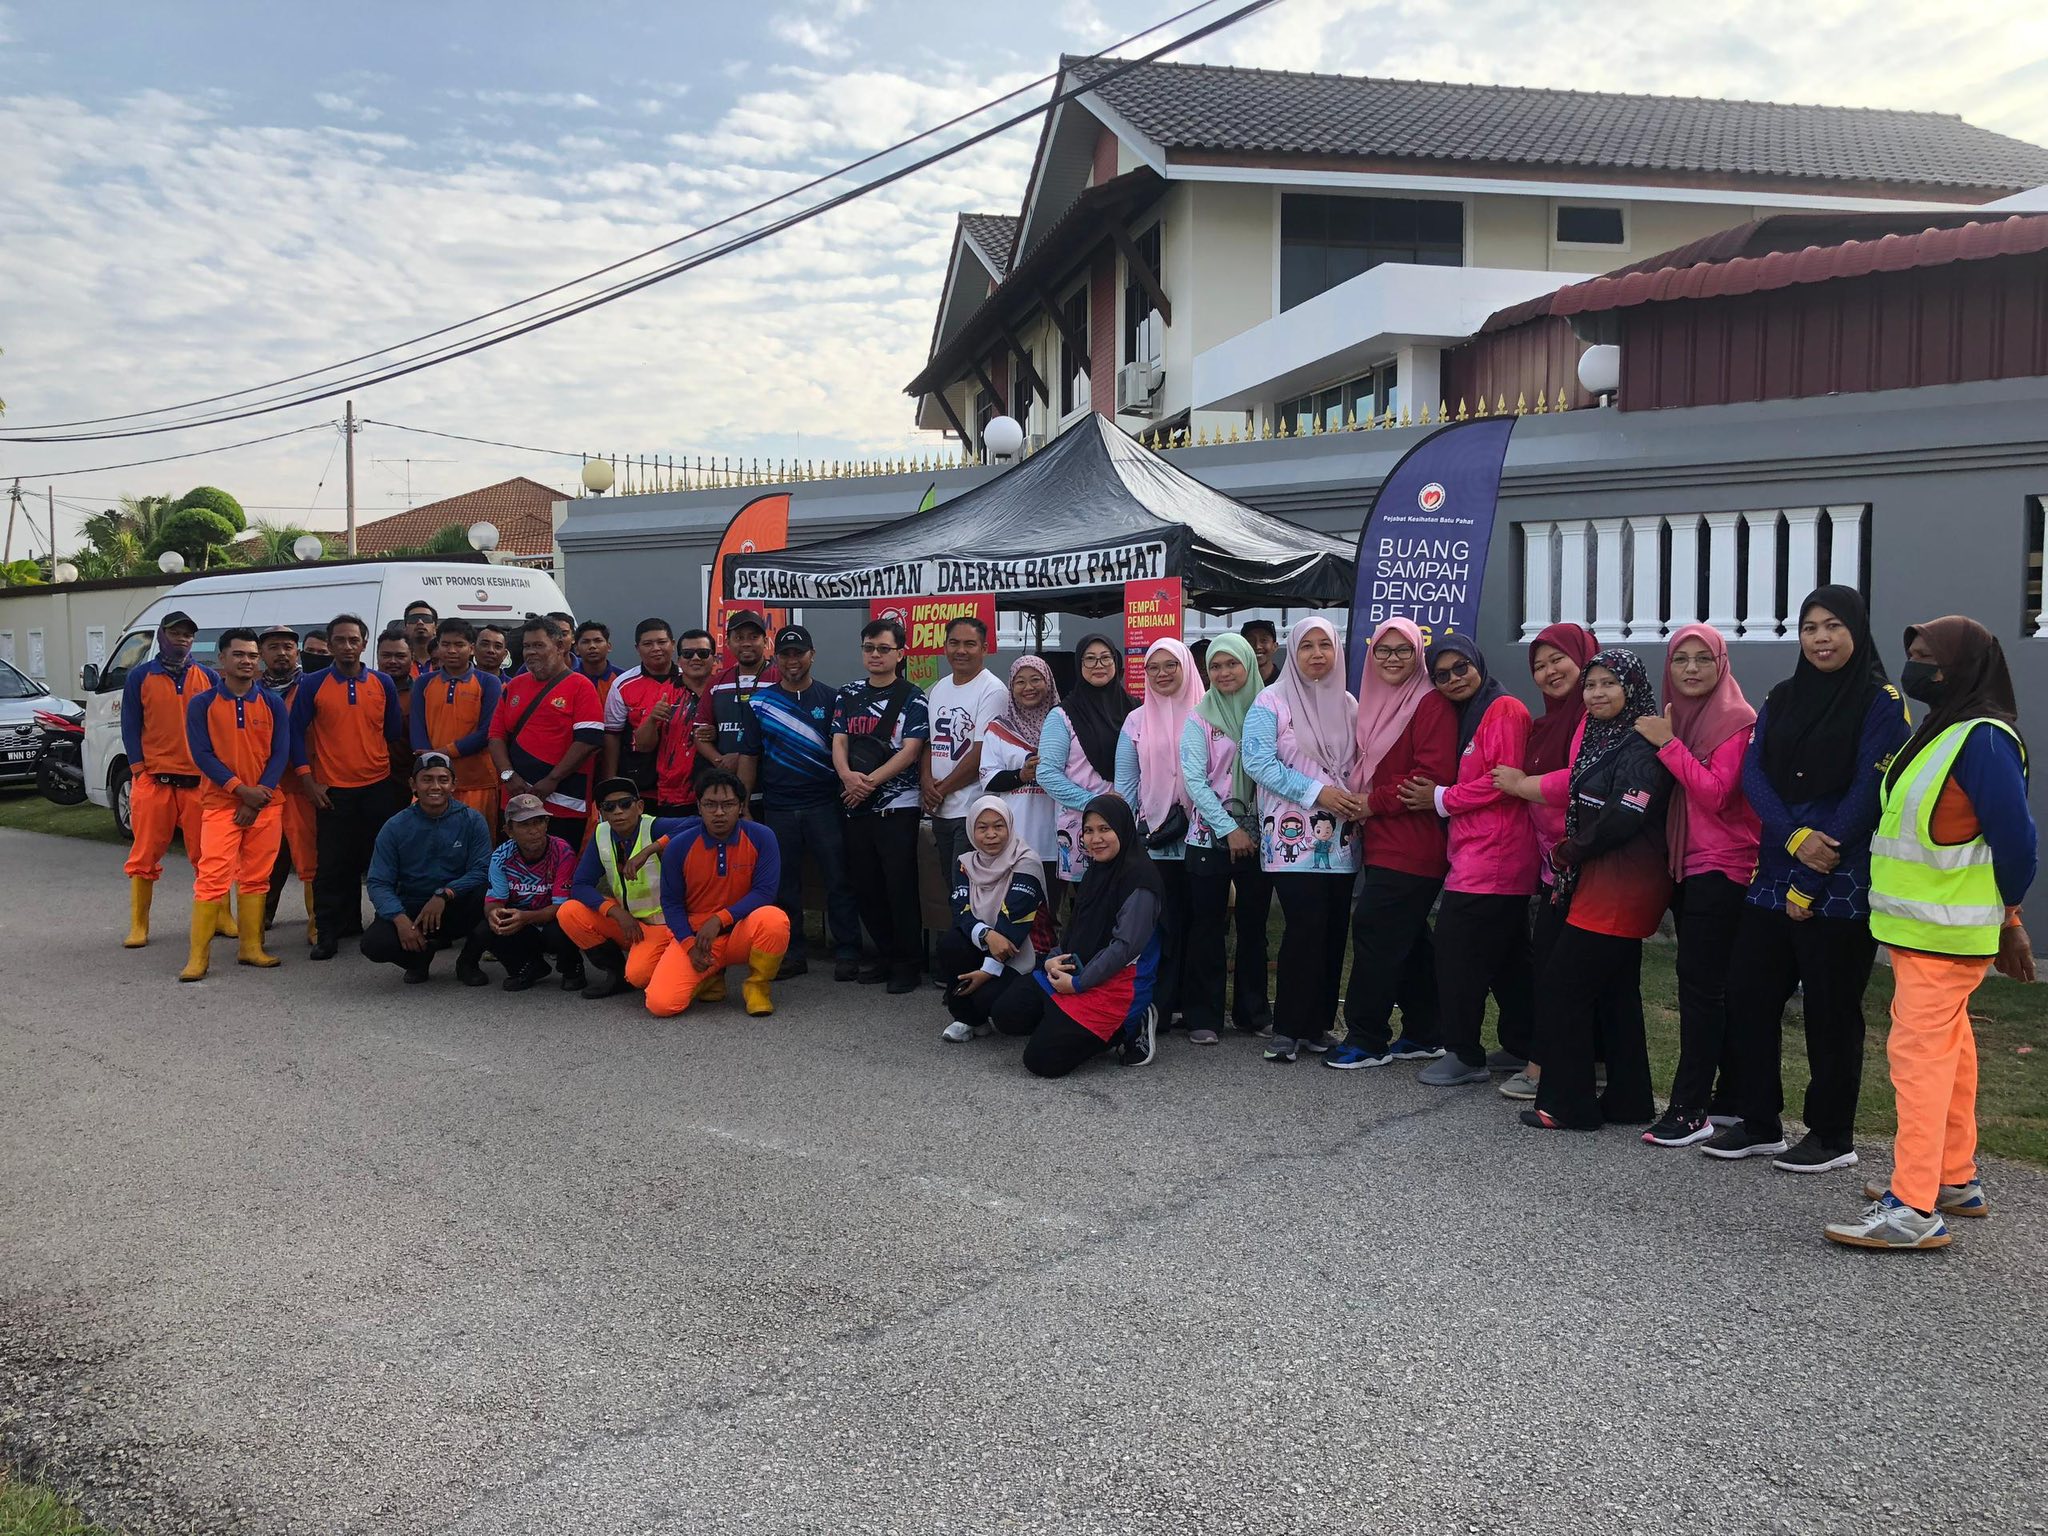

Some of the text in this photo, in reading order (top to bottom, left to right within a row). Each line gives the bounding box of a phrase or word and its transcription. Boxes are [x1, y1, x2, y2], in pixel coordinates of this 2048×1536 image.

[1383, 515, 1406, 523] Pejabat
[1378, 538, 1469, 560] BUANG
[737, 543, 1162, 599] PEJABAT KESIHATAN DAERAH BATU PAHAT
[1376, 560, 1469, 581] SAMPAH
[421, 576, 531, 588] UNIT PROMOSI KESIHATAN
[1372, 581, 1466, 603] DENGAN
[911, 602, 978, 621] INFORMASI
[1127, 600, 1160, 614] TEMPAT
[1369, 604, 1460, 625] BETUL
[1127, 613, 1175, 629] PEMBIAKAN
[7, 751, 24, 760] WNN
